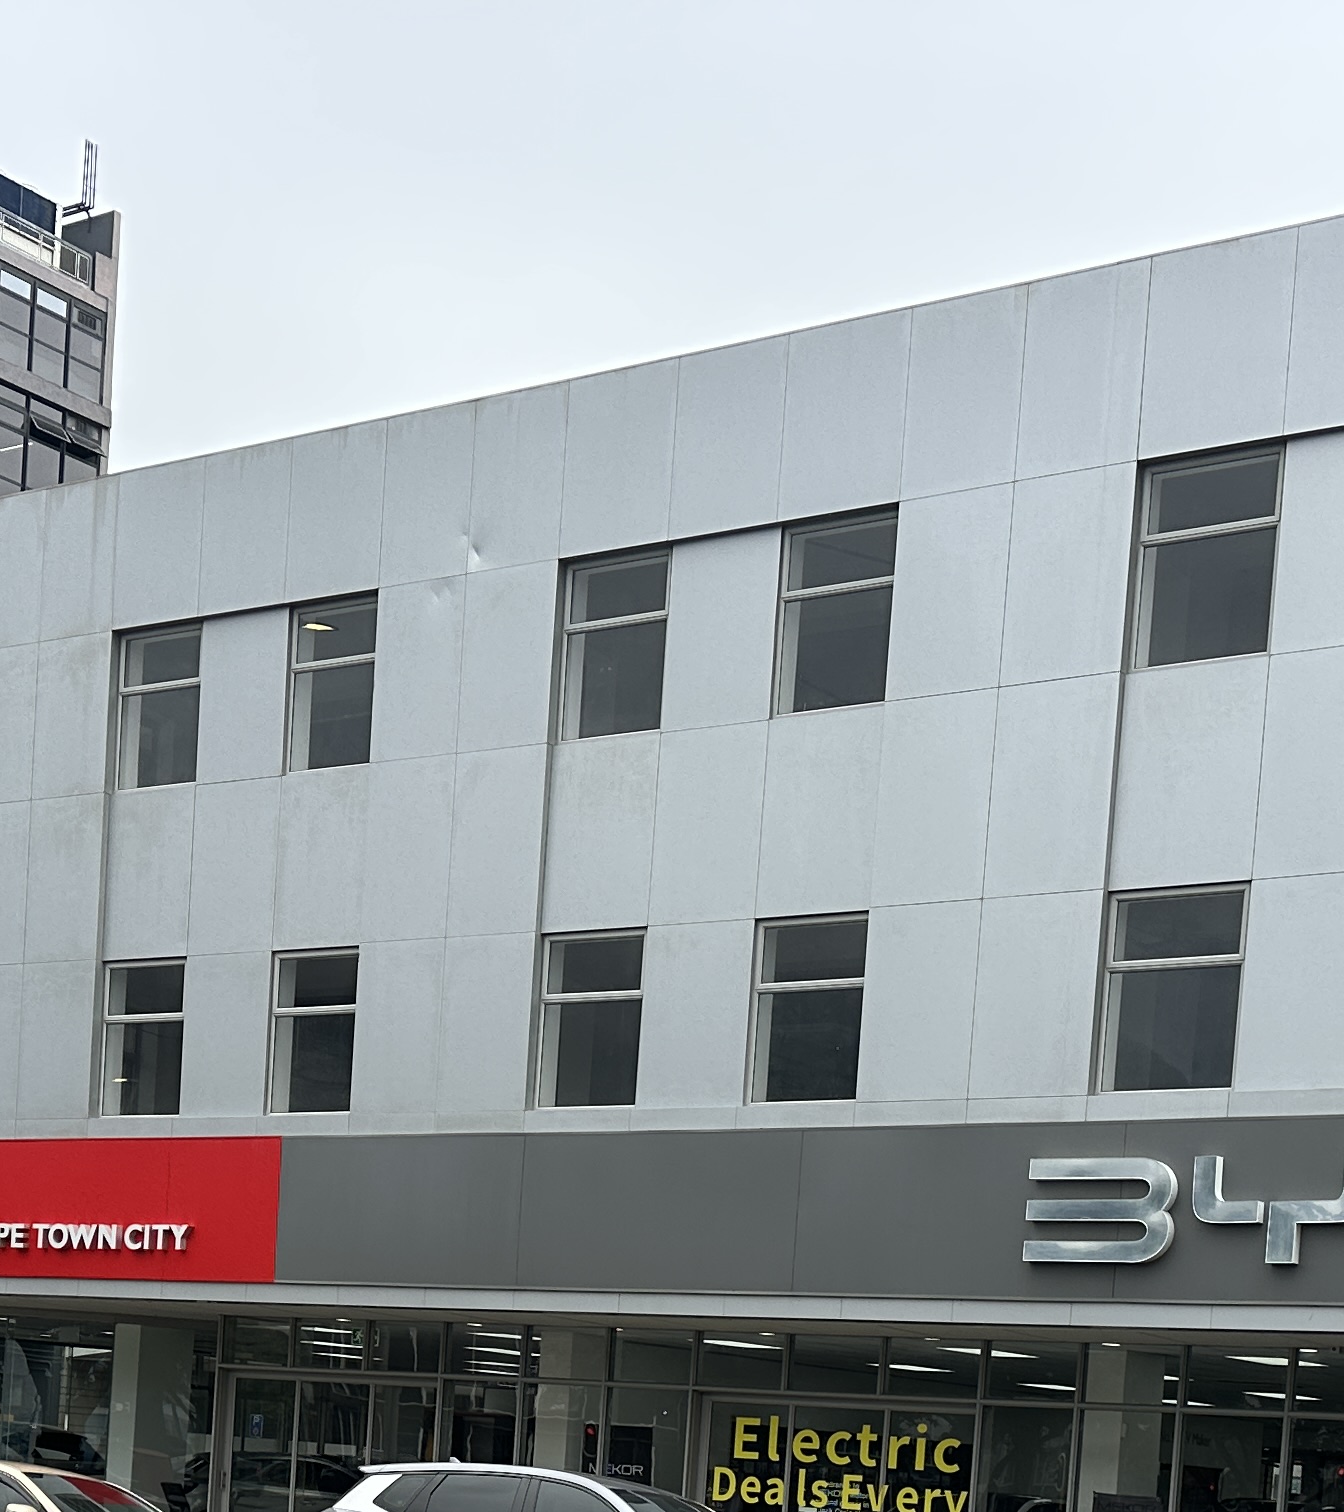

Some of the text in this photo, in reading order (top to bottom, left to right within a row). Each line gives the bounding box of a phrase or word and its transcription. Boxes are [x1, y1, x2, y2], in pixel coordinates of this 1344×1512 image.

[32, 1222, 122, 1250] TOWN
[123, 1223, 191, 1250] CITY
[733, 1415, 960, 1473] Electric
